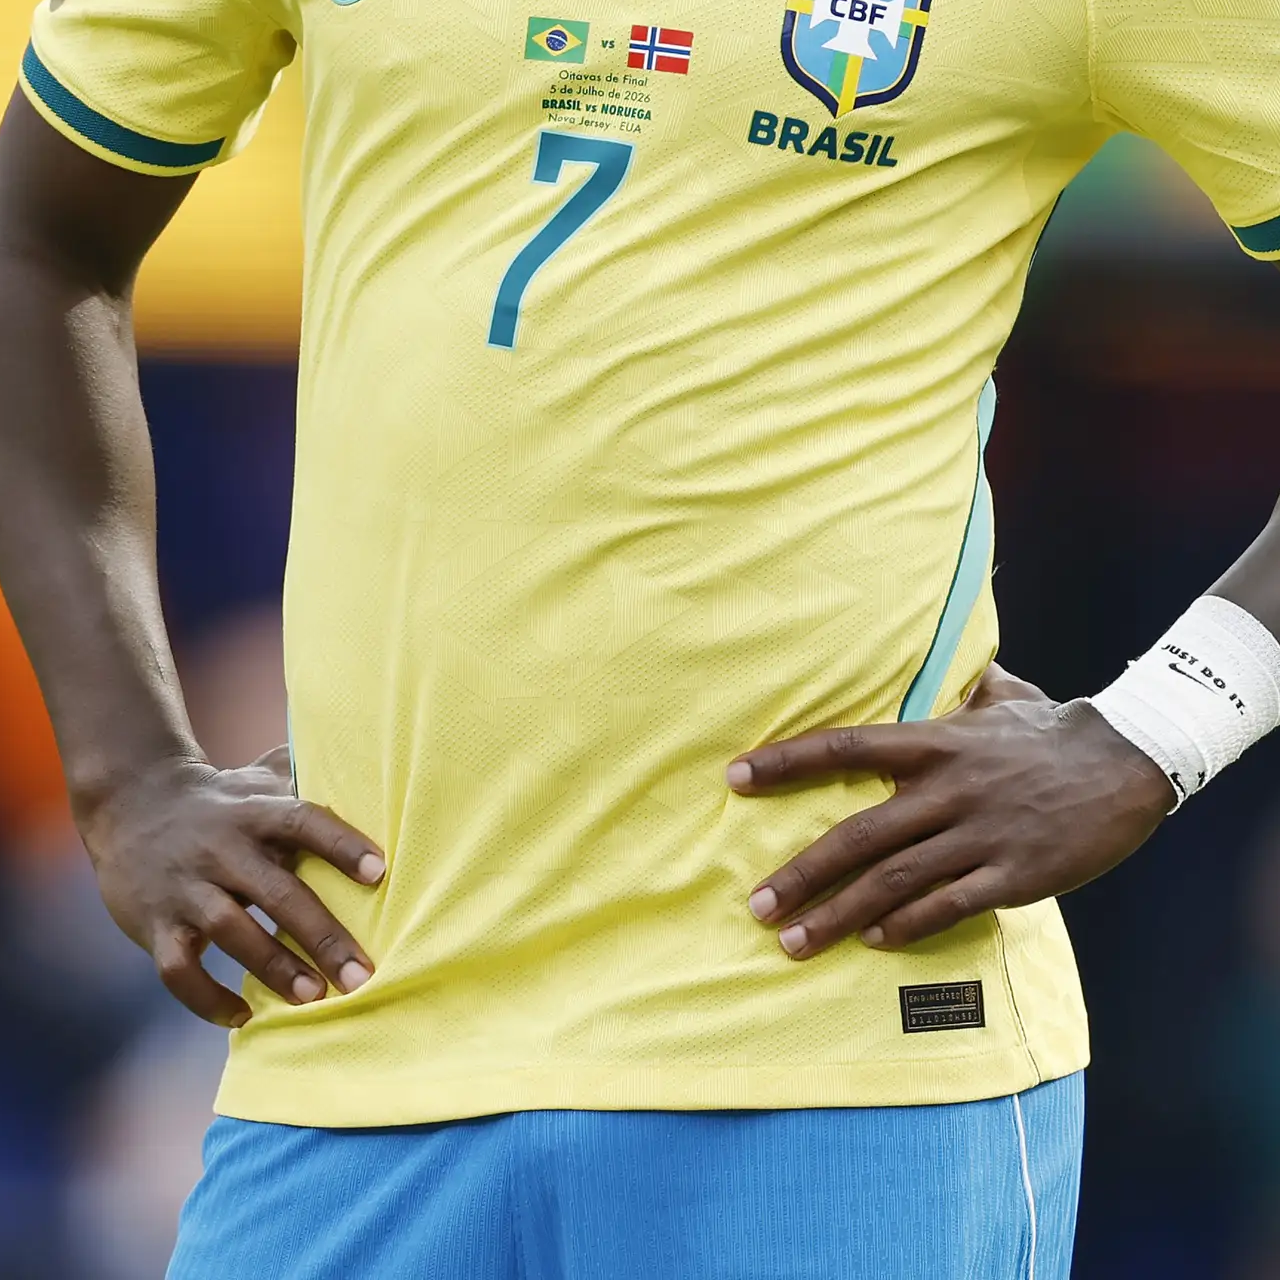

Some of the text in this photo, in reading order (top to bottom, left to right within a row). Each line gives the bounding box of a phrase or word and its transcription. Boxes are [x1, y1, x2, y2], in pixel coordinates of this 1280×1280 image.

[601, 39, 615, 49] vs
[559, 70, 648, 86] Oitavas de Final
[549, 84, 651, 103] 5 de Julho de 2026
[542, 99, 652, 120] BRASIL vs NORUEGA
[548, 113, 575, 124] Nova
[578, 117, 611, 131] Jersey
[620, 122, 642, 134] EUA
[747, 109, 899, 168] BRASIL
[487, 130, 635, 350] 7
[1161, 644, 1199, 665] JUST
[1200, 666, 1226, 689] DO
